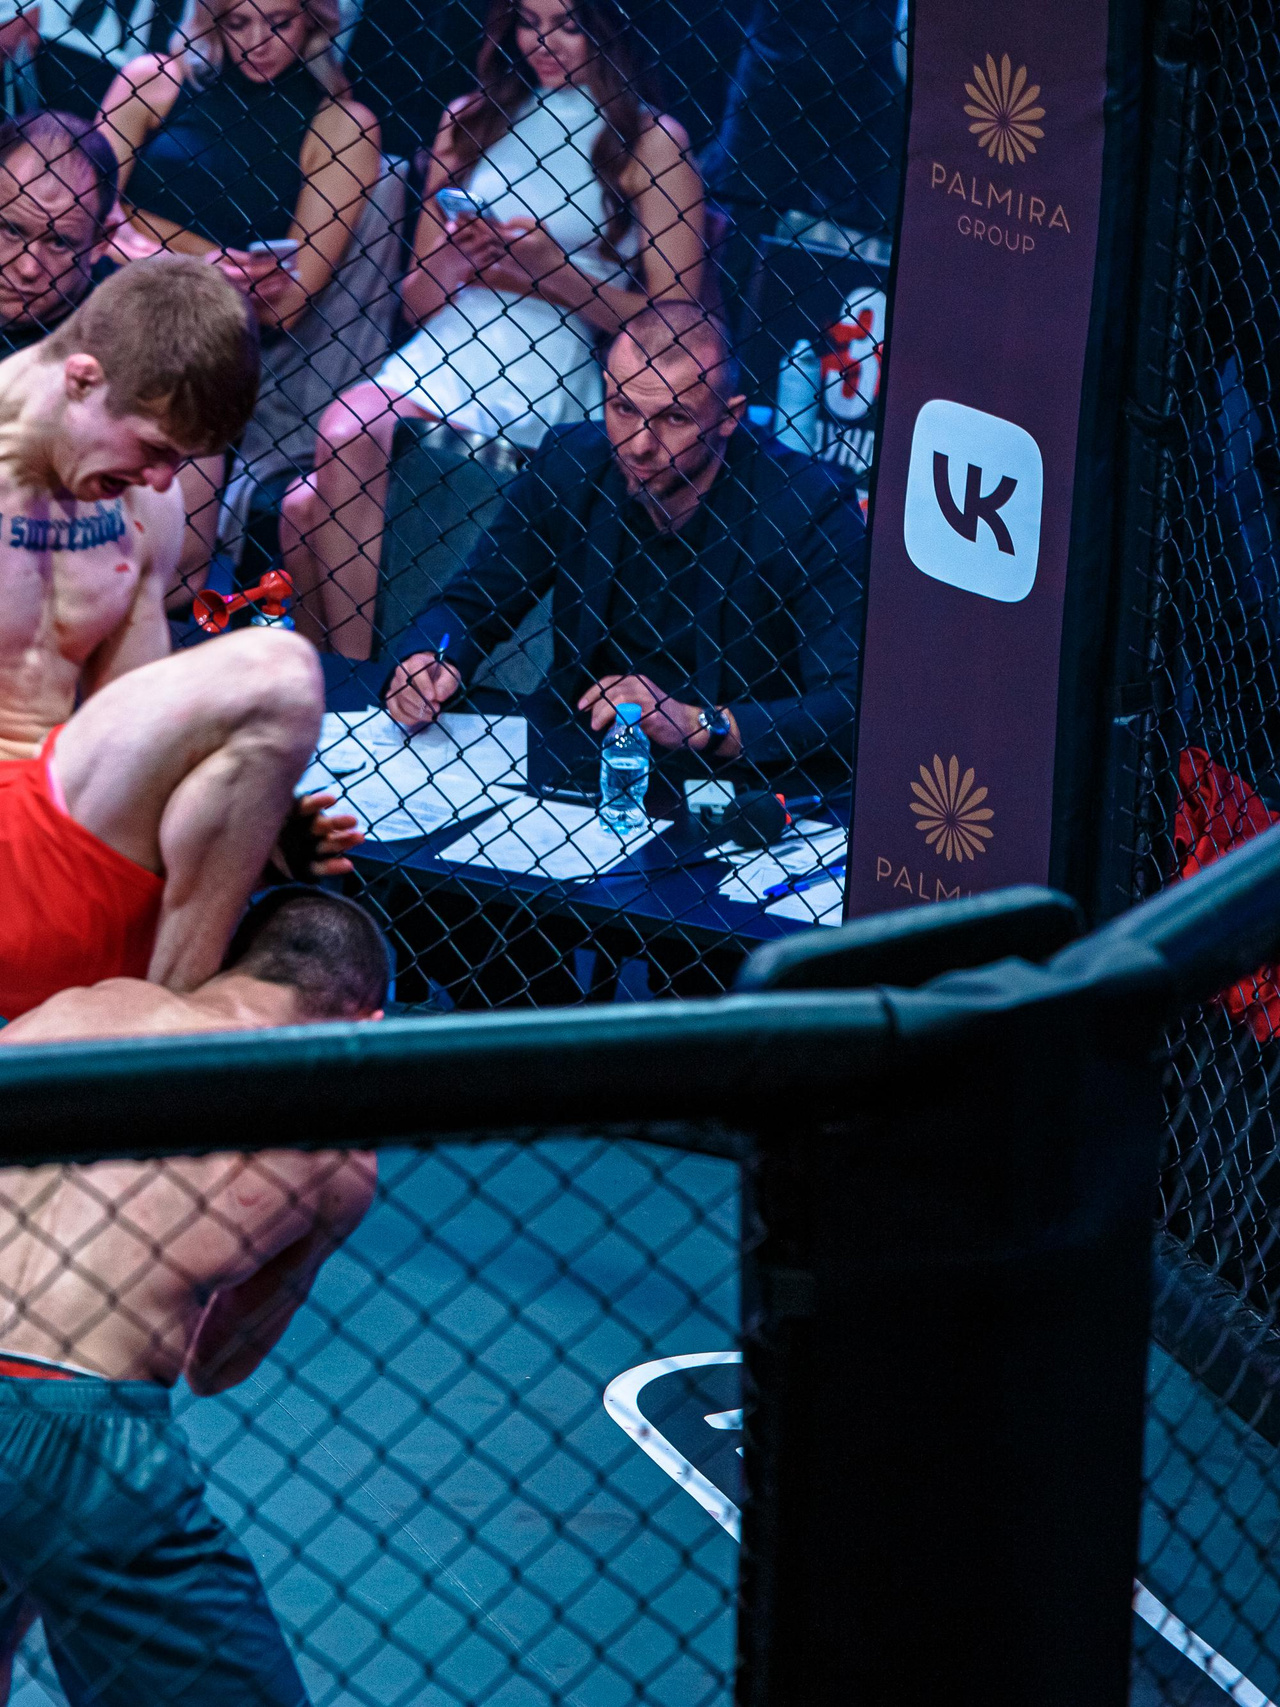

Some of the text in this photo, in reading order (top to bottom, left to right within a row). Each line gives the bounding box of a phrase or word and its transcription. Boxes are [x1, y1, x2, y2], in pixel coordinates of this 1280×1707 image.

[931, 162, 1071, 234] PALMIRA
[957, 215, 1036, 255] GROUP
[932, 449, 1019, 557] VK
